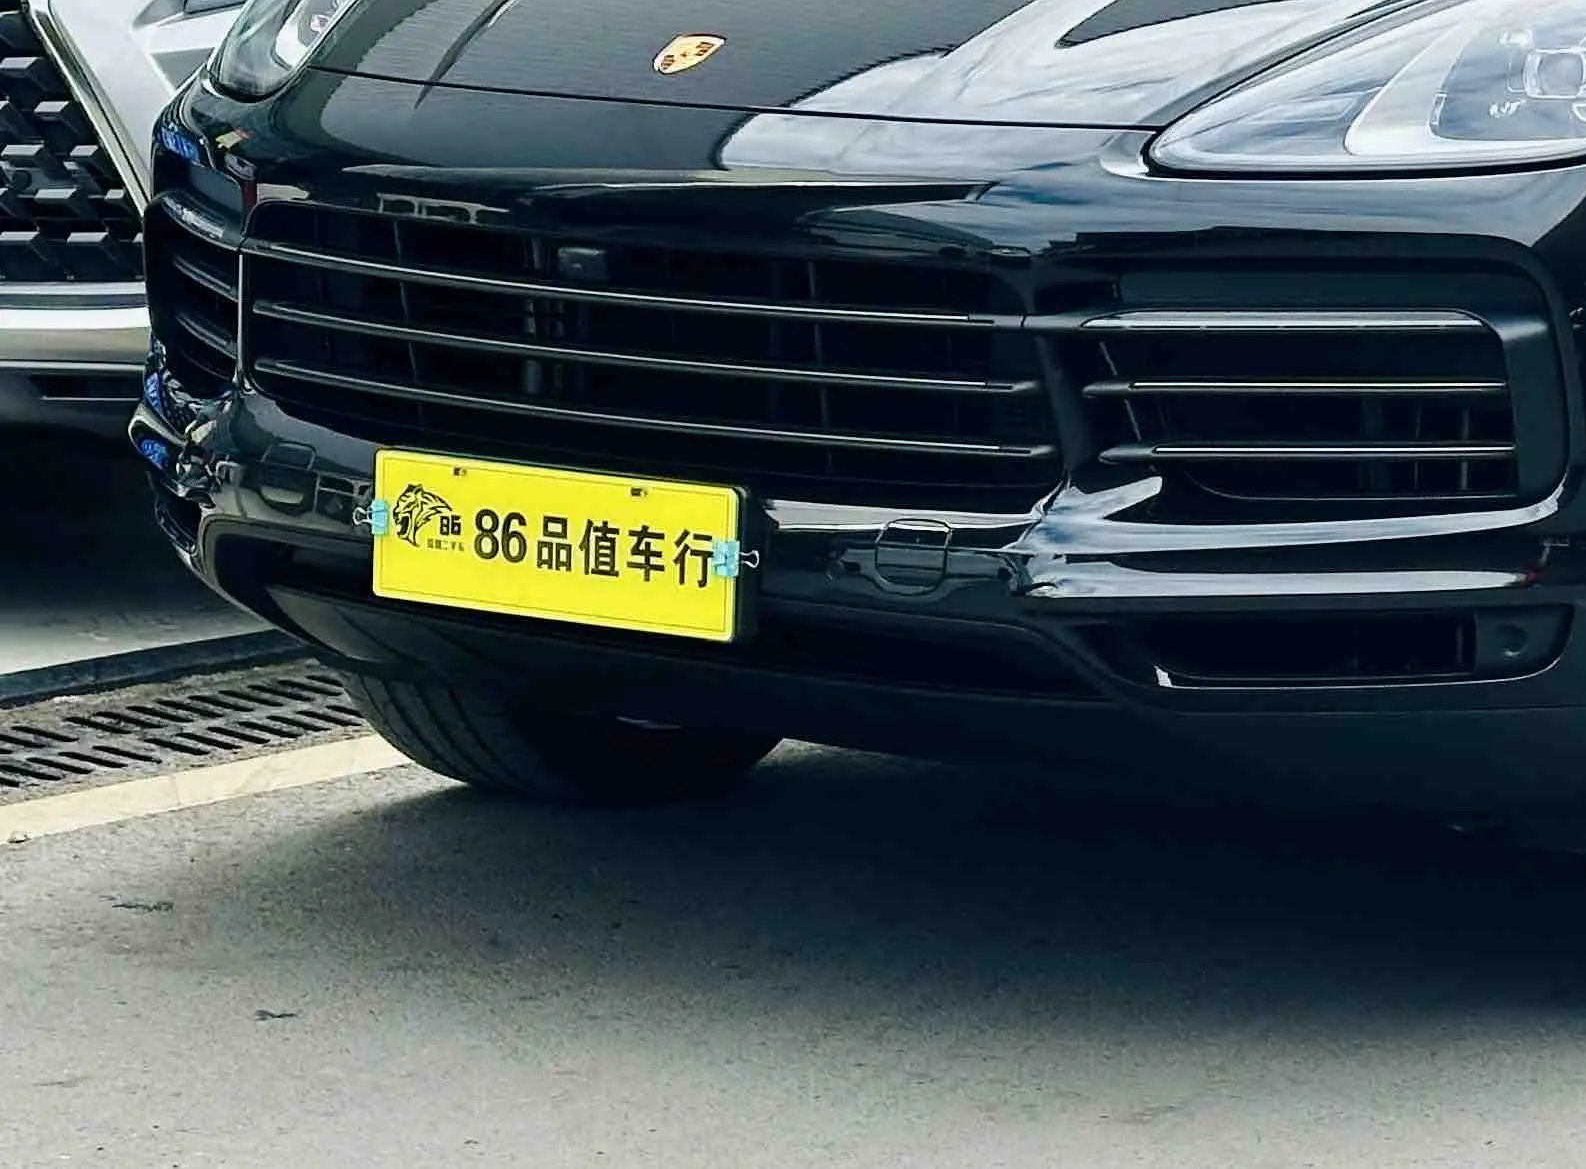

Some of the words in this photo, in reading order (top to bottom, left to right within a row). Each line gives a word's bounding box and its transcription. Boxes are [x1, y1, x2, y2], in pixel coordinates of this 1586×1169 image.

[440, 515, 462, 536] 86
[473, 508, 715, 588] 86品值车行
